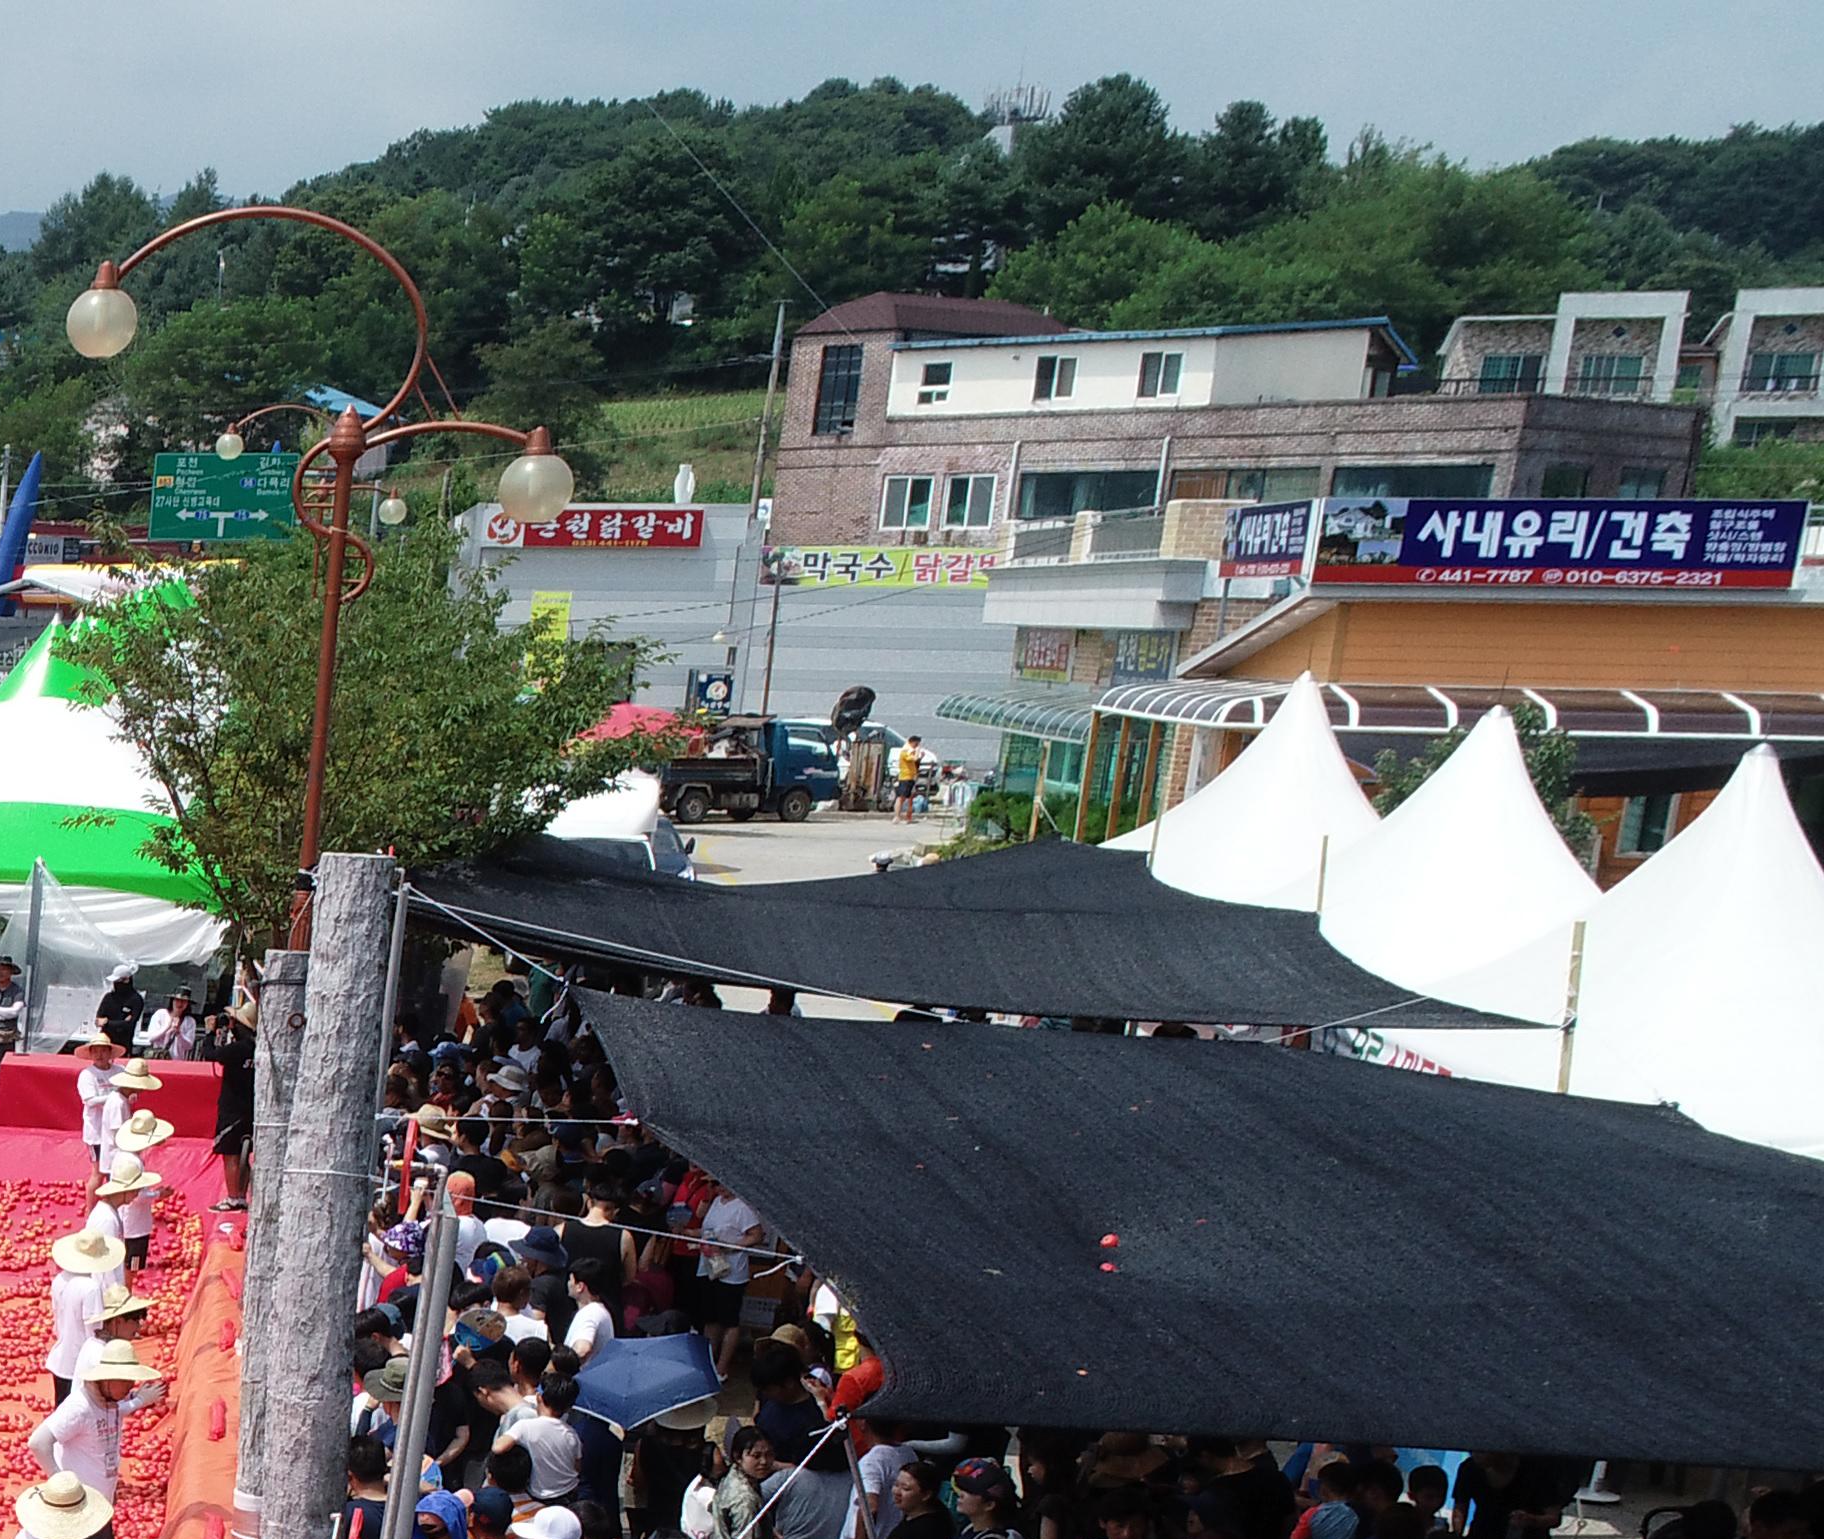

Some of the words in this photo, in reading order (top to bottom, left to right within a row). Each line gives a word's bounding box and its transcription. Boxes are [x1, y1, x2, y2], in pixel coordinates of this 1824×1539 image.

[1416, 509, 1693, 560] 사내유리/건축
[802, 551, 895, 582] 막국수
[1437, 568, 1534, 583] 441-7787
[1565, 570, 1723, 586] 010-6375-2321
